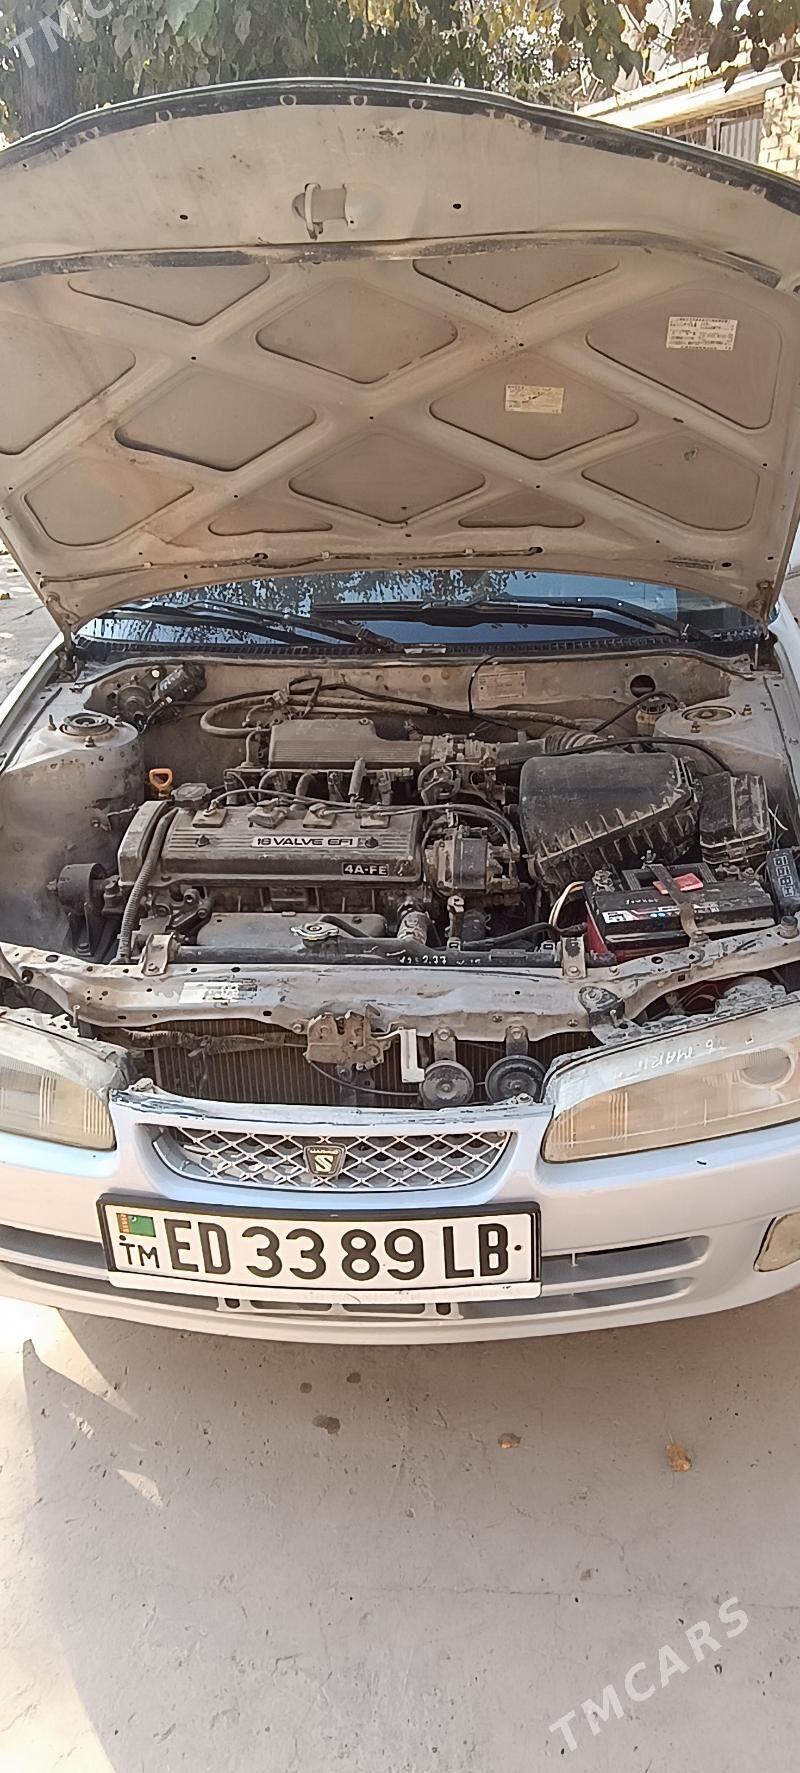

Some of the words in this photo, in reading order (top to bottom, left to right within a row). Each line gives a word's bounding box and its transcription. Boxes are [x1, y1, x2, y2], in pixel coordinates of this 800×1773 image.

[273, 837, 324, 846] VALVE
[328, 837, 353, 846] EFI
[344, 864, 388, 875] 4A-FE
[119, 1242, 161, 1269] TM
[164, 1218, 231, 1275] ED
[443, 1222, 509, 1280] LB
